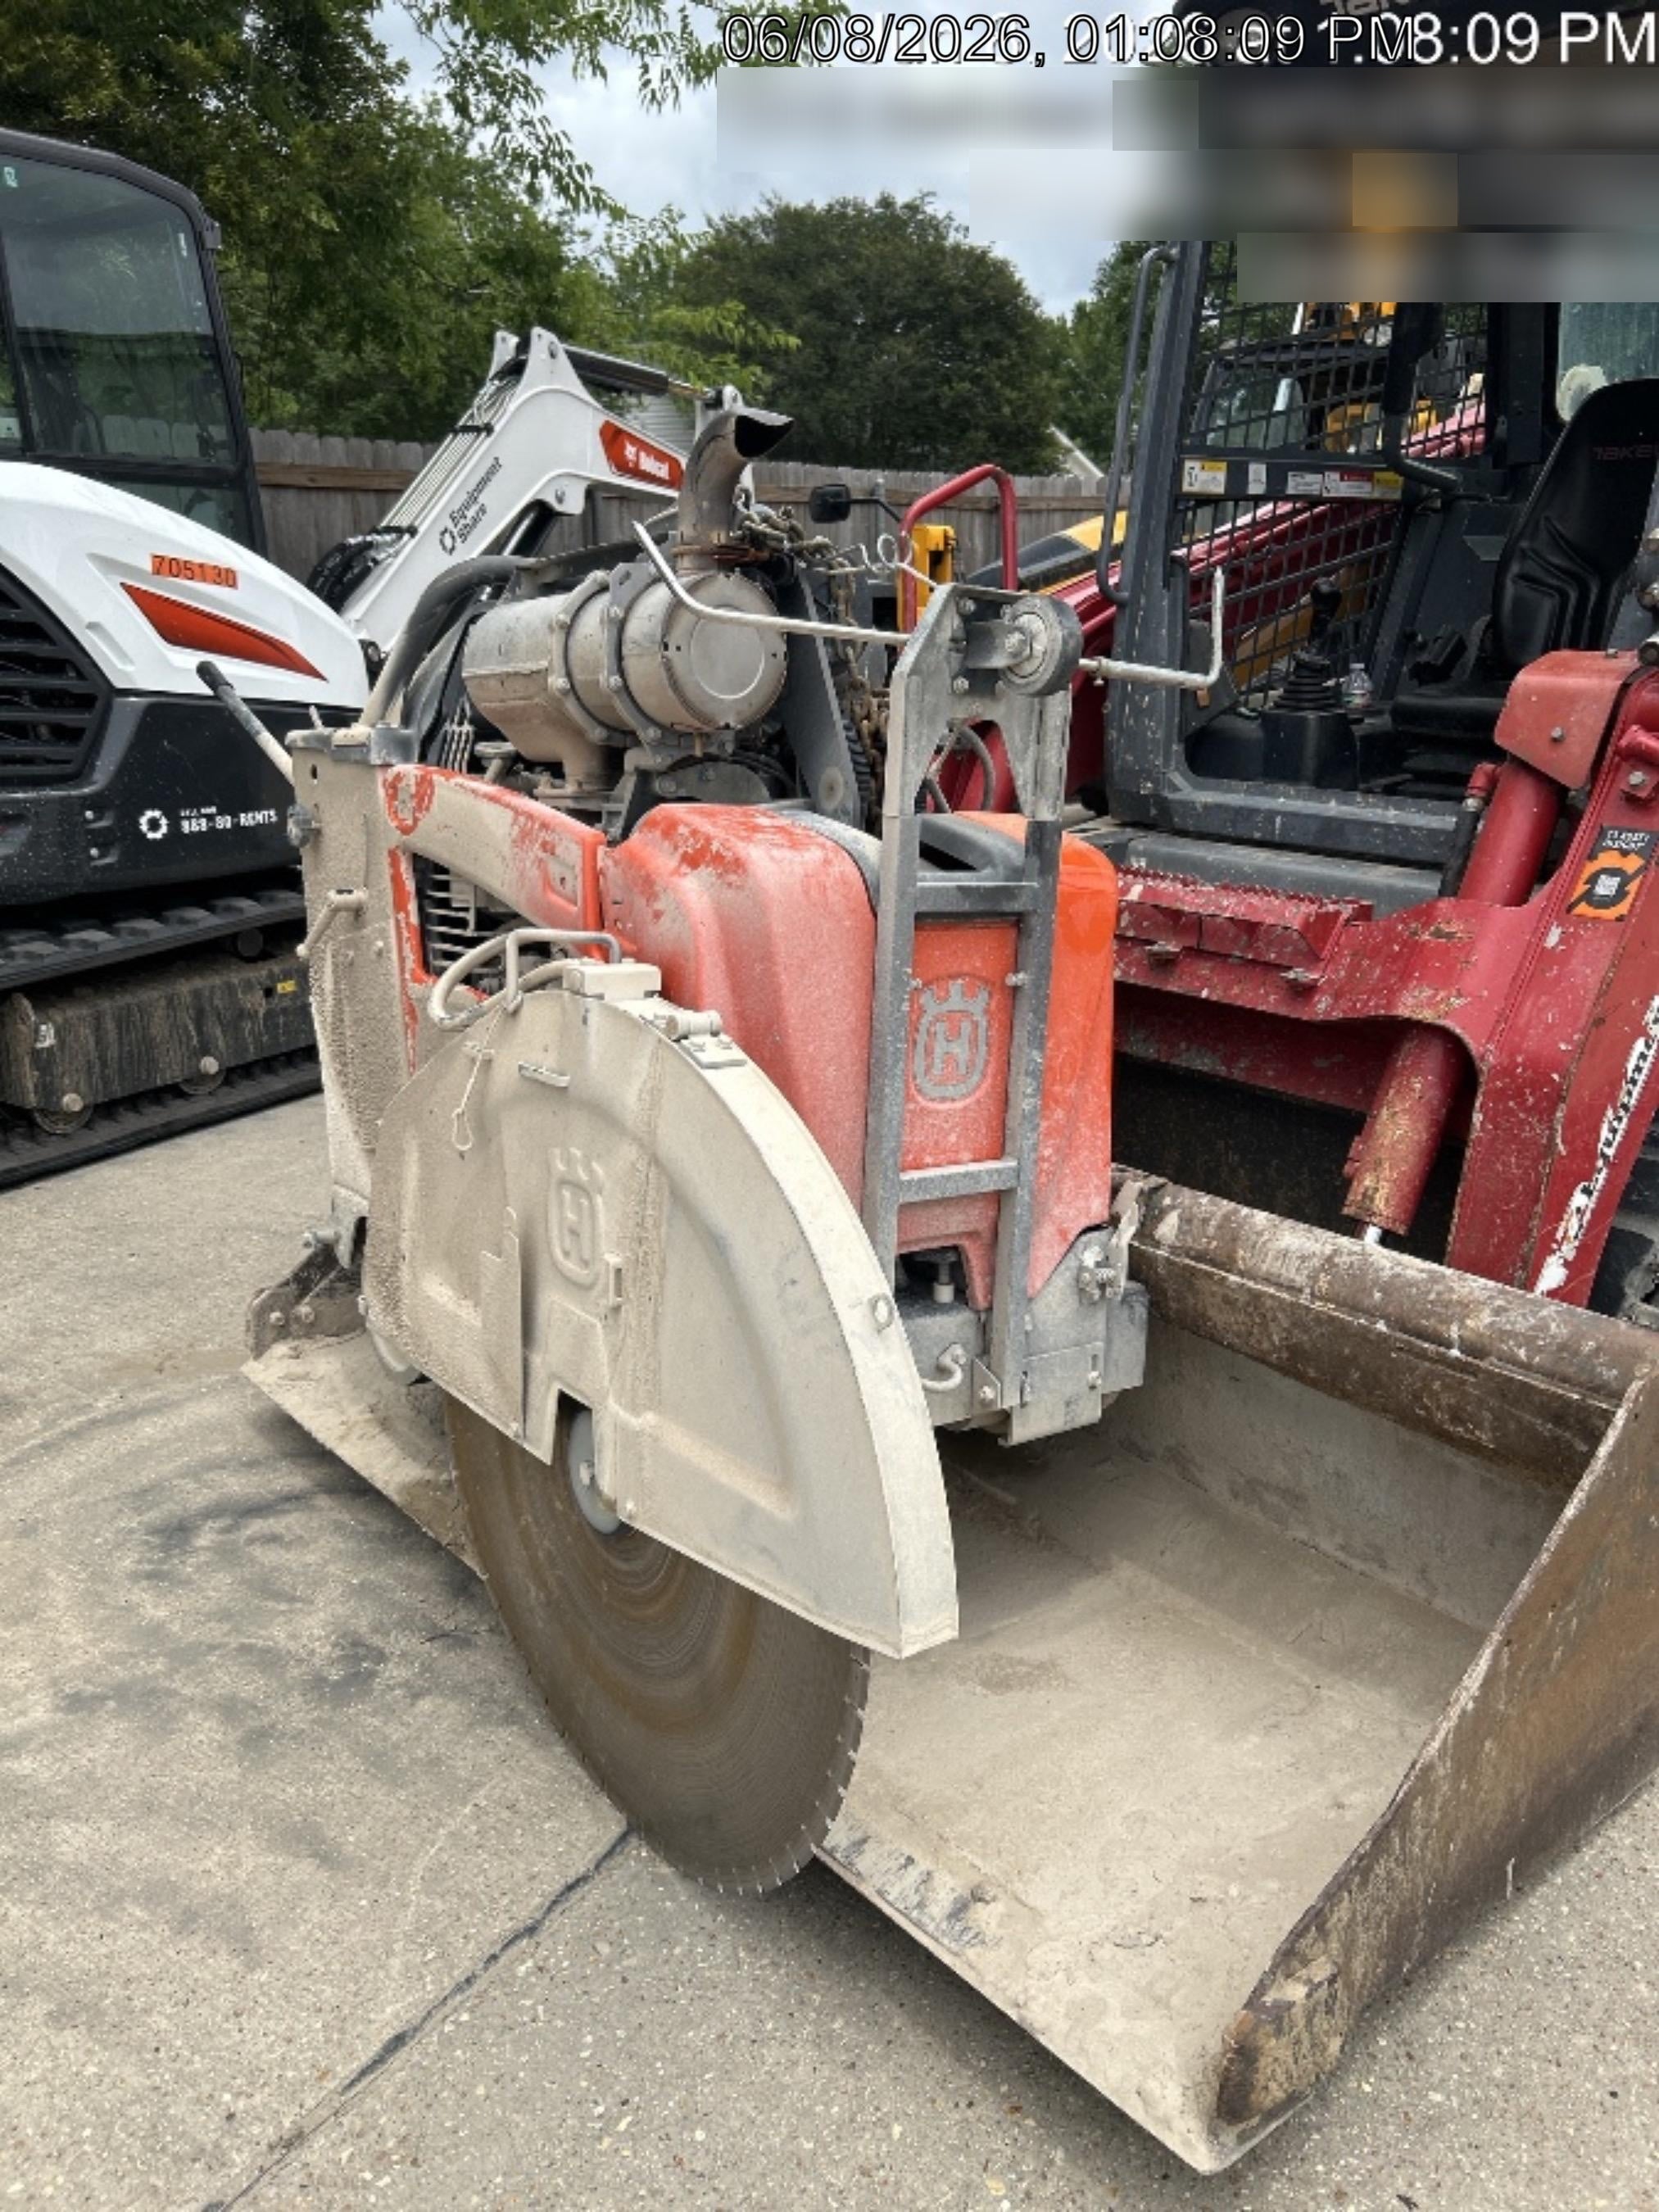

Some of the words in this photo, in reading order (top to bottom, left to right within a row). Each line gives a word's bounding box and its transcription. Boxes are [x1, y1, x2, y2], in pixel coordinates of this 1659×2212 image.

[449, 456, 502, 528] Equipment
[457, 503, 487, 544] Share
[152, 555, 238, 588] 705130
